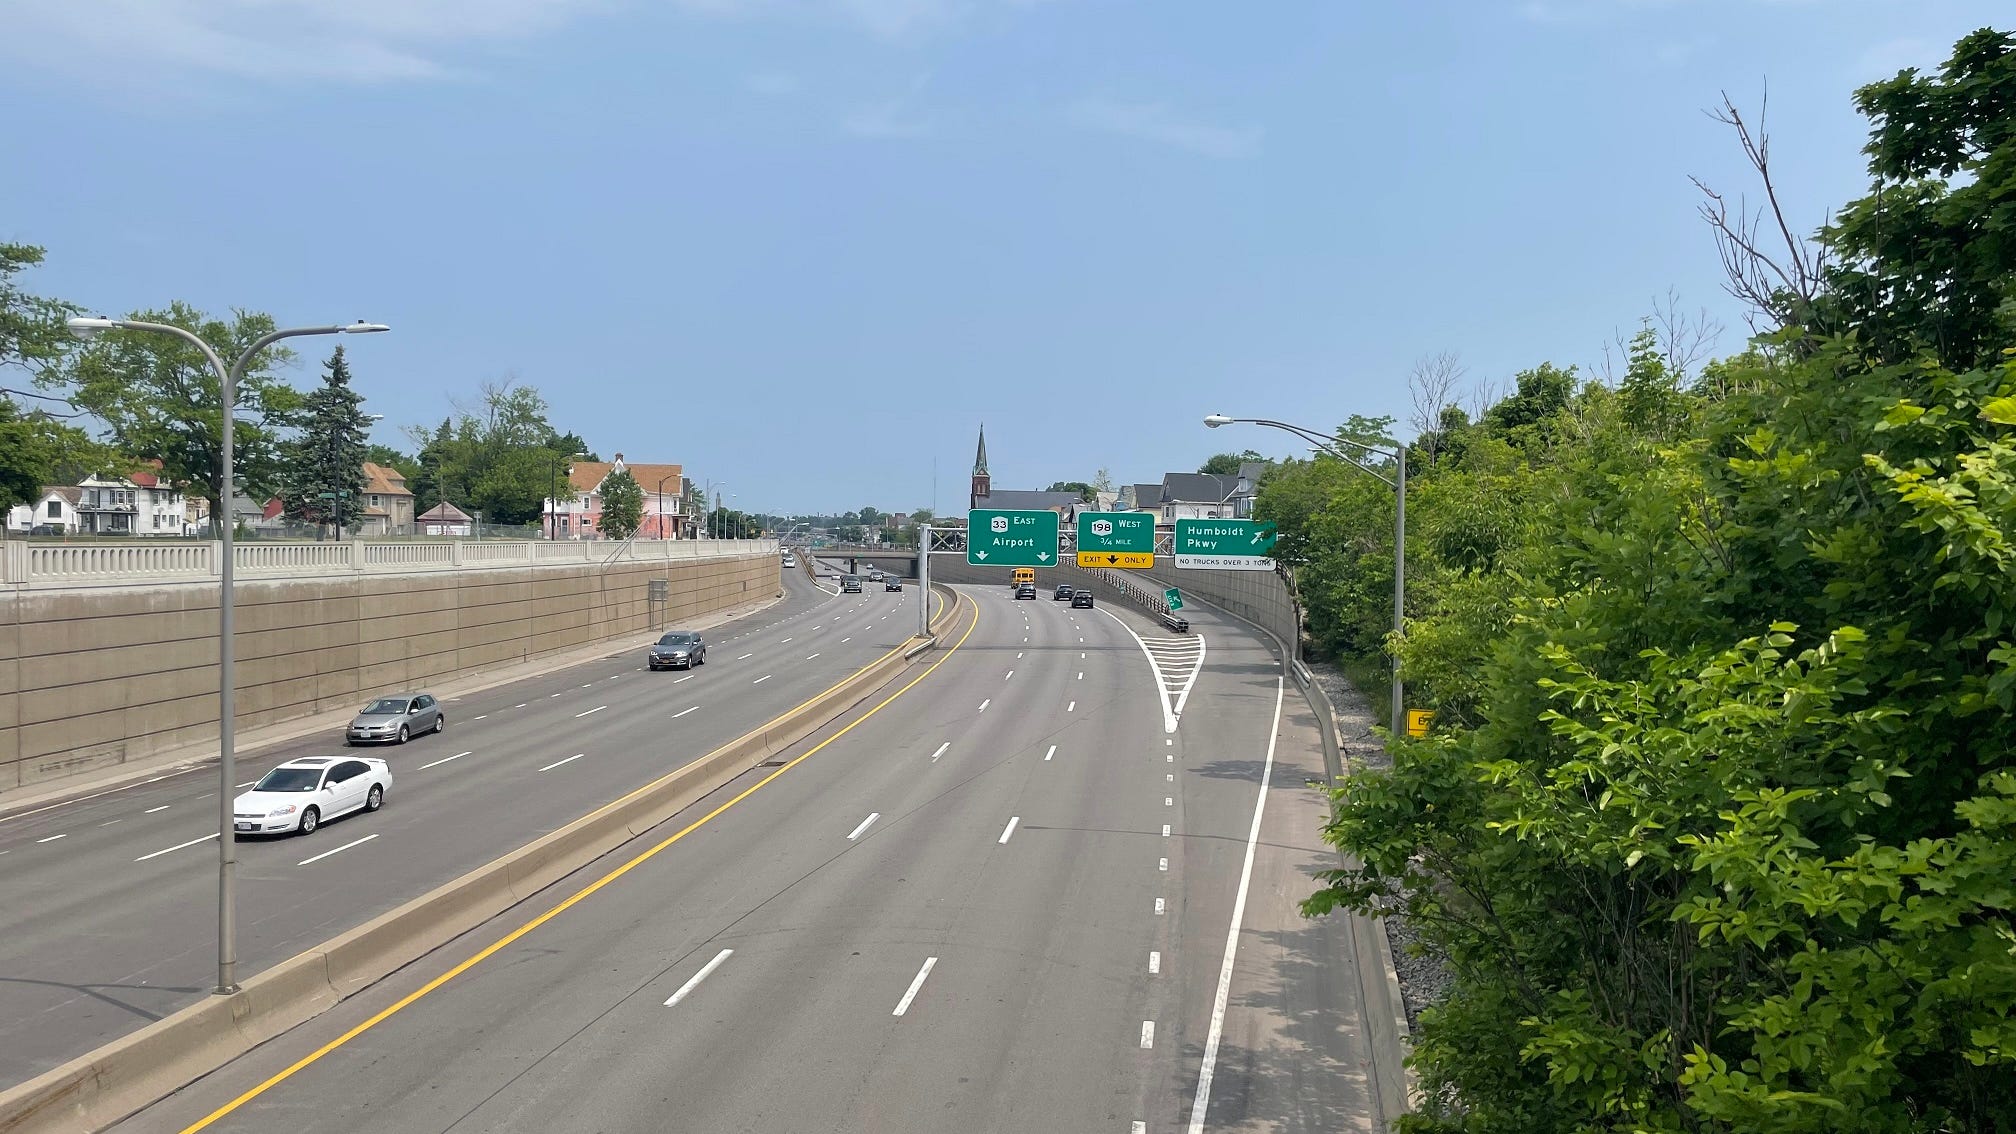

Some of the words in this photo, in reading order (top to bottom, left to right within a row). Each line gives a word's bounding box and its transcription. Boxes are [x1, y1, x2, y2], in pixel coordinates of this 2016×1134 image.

[992, 520, 1007, 529] 33
[1013, 517, 1035, 525] EAST
[1118, 519, 1141, 528] WEST
[1093, 523, 1111, 532] 198
[1187, 526, 1244, 536] Humboldt
[992, 537, 1034, 548] Airport
[1100, 537, 1112, 546] 3/4
[1187, 539, 1217, 550] Pkwy
[1124, 556, 1146, 564] ONLY
